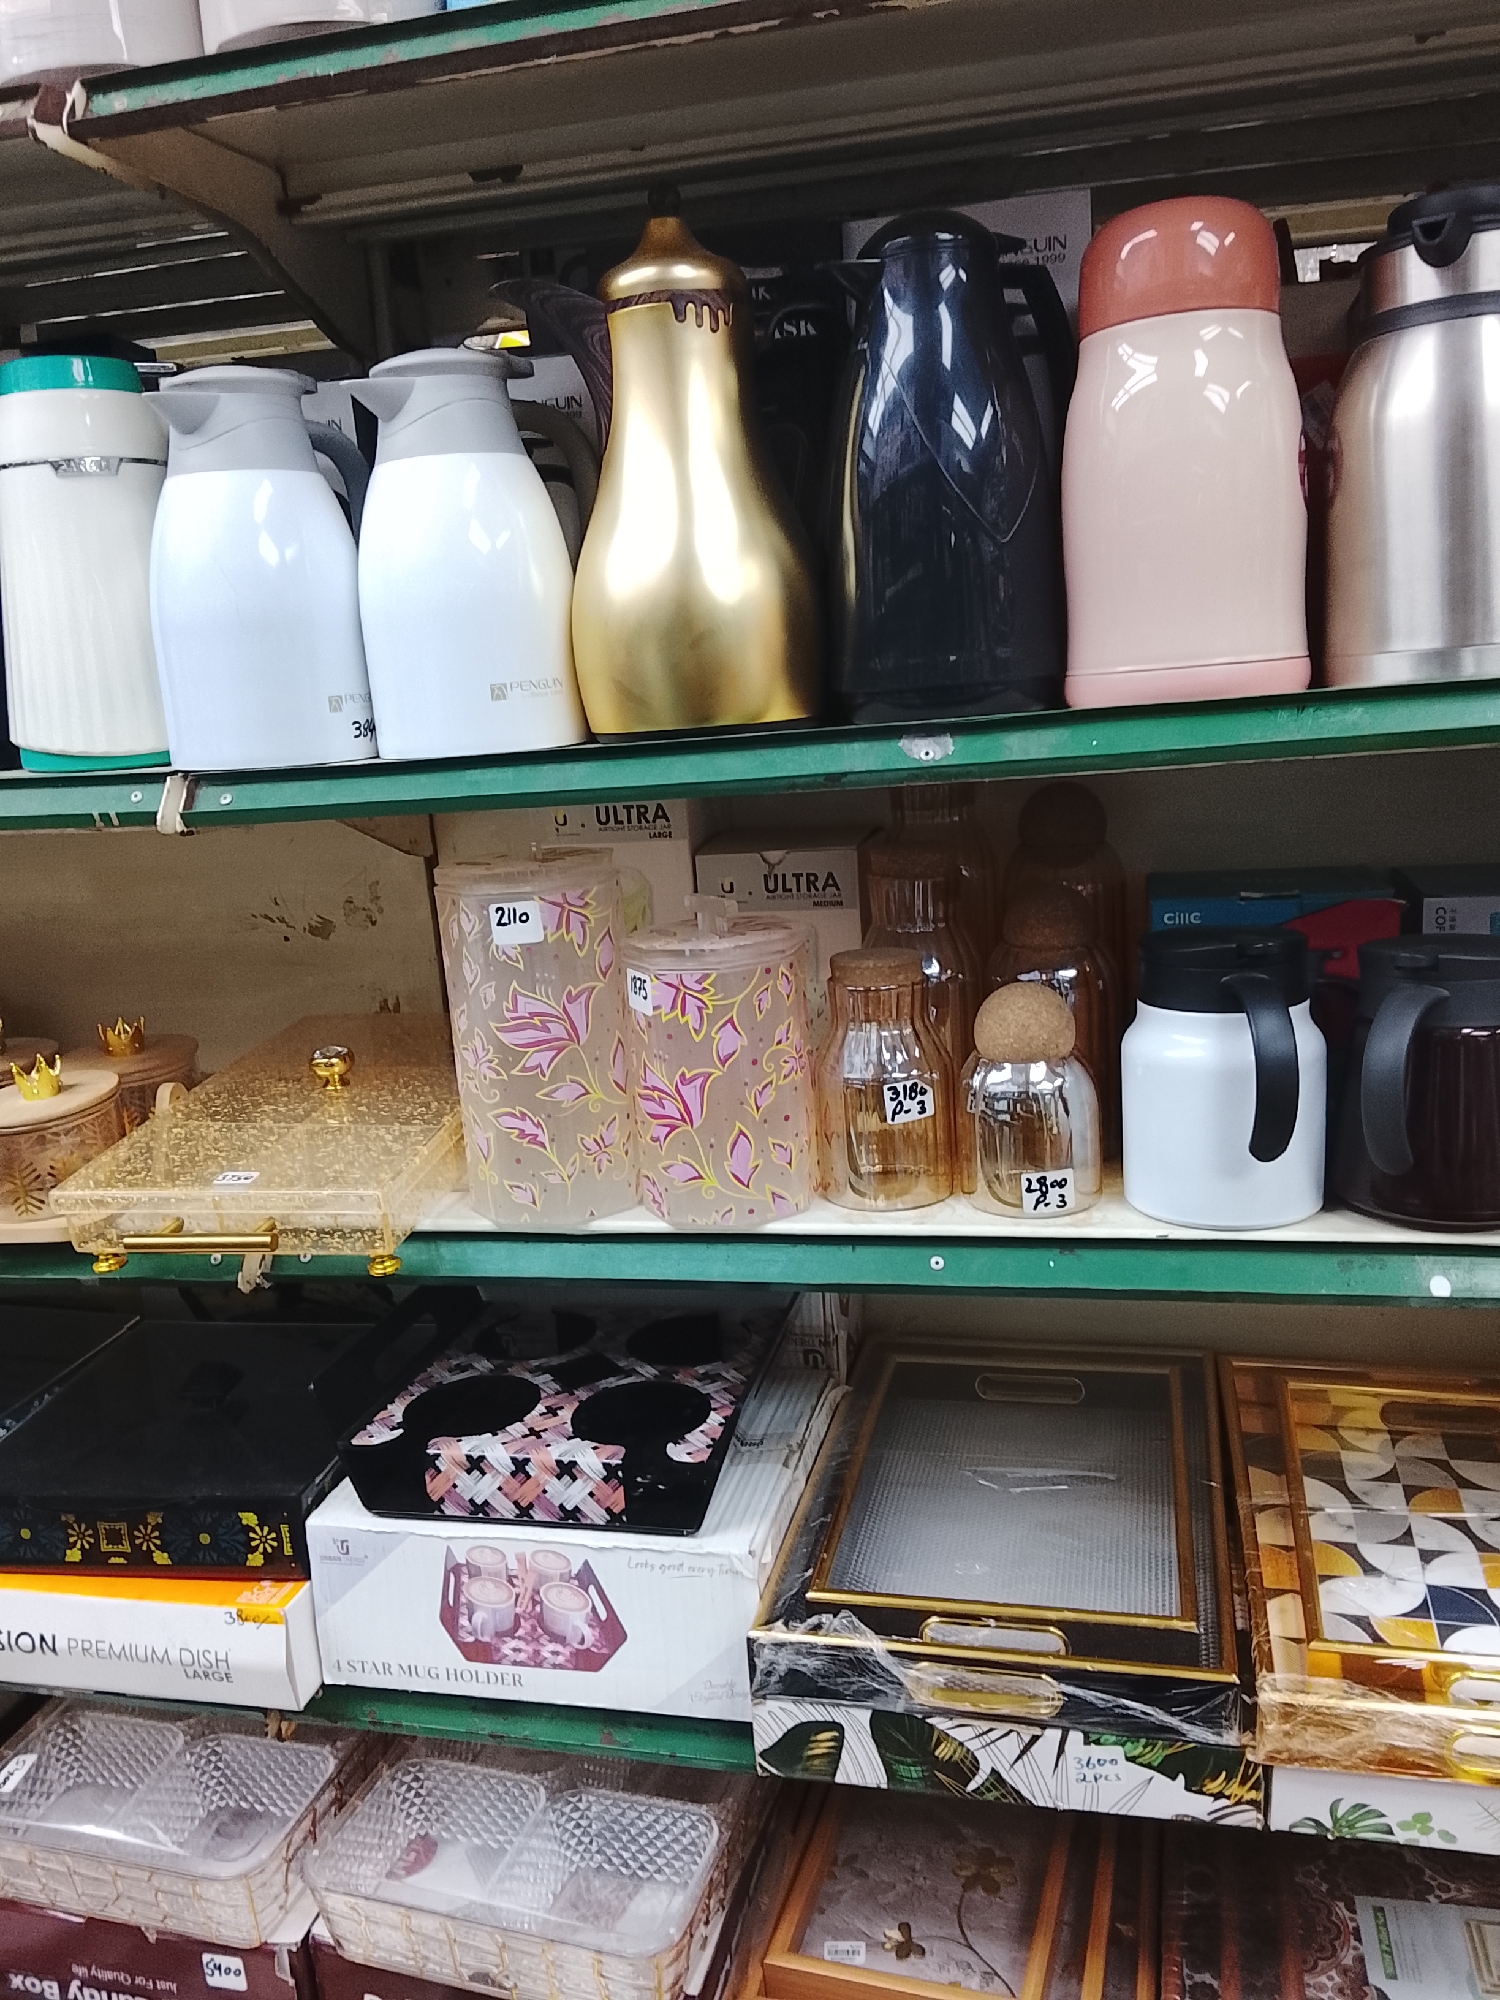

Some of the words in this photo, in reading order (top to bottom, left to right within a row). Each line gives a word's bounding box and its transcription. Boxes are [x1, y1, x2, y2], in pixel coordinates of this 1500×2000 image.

[509, 678, 564, 693] PENGUIN
[595, 803, 671, 826] ULTRA
[648, 831, 673, 839] LARGE
[763, 871, 841, 893] ULTRA
[495, 906, 530, 927] 2110
[630, 974, 648, 1001] 1875
[887, 1081, 929, 1101] 3180
[1025, 1175, 1068, 1195] 2800
[627, 1556, 655, 1572] Looks
[659, 1562, 684, 1574] good
[66, 1637, 173, 1666] PREMIUM
[178, 1647, 232, 1671] DISH
[184, 1668, 234, 1684] LARGE
[333, 1659, 342, 1673] 4
[347, 1660, 393, 1677] STAR
[397, 1663, 440, 1680] MUG
[446, 1667, 524, 1688] HOLDER
[1073, 1756, 1119, 1770] 3600
[90, 1964, 132, 1986] Quality
[205, 1957, 242, 1977] 5400
[9, 1973, 59, 2000] Box
[134, 1975, 154, 1990] For
[155, 1979, 177, 1994] Just
